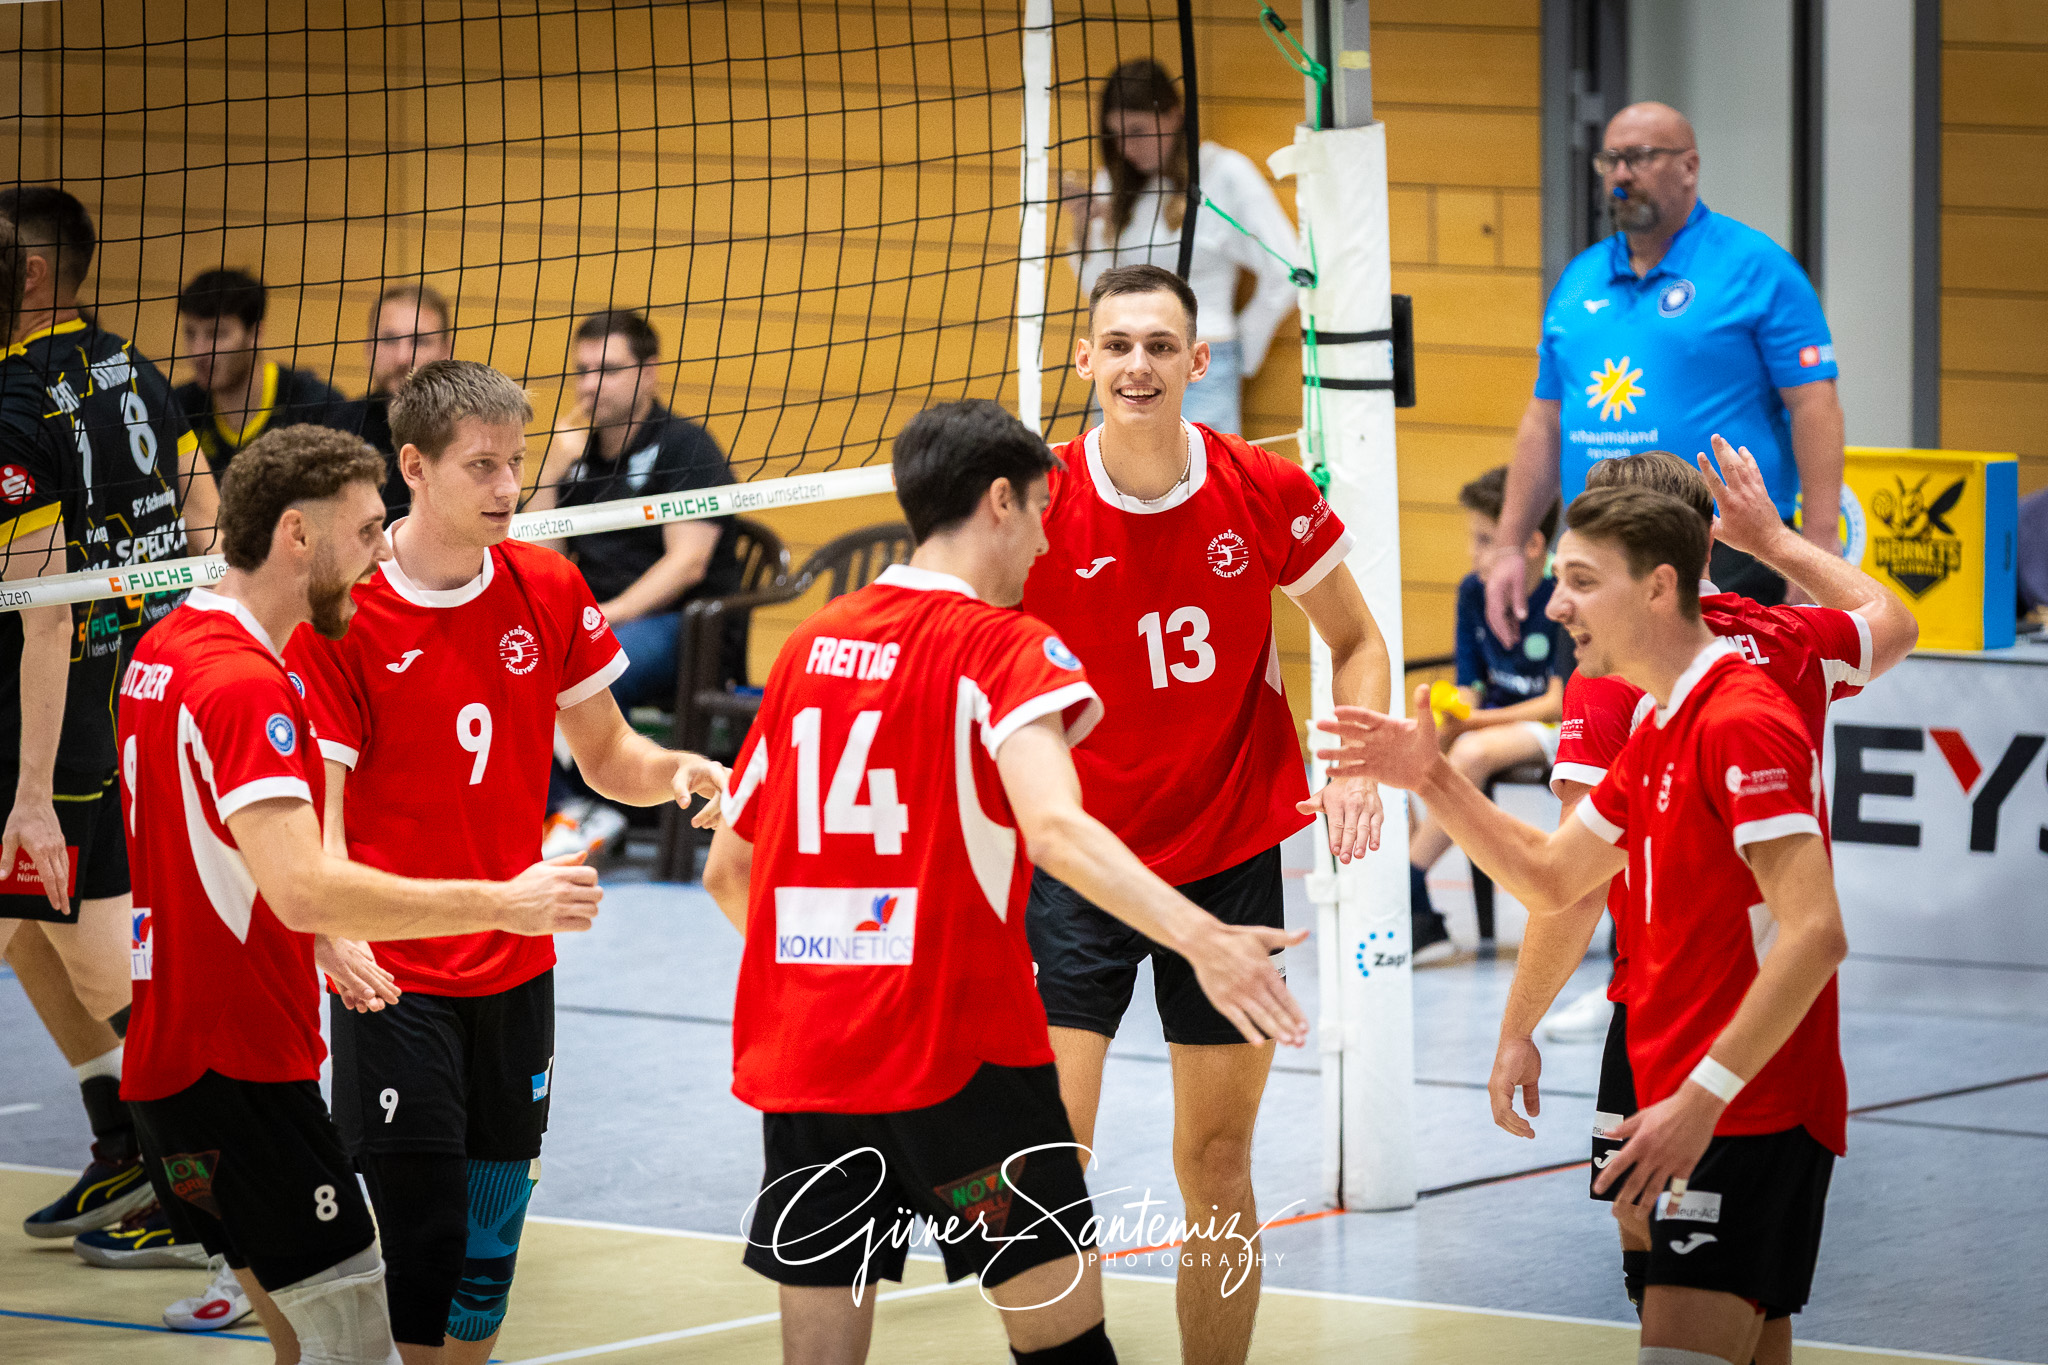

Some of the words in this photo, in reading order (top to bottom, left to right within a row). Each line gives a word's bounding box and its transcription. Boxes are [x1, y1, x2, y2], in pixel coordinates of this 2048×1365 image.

[660, 496, 719, 518] FUCHS
[729, 490, 764, 509] Ideen
[767, 483, 825, 504] umsetzen
[512, 518, 574, 539] umsetzen
[1208, 537, 1219, 550] TUS
[1218, 530, 1245, 546] KRIFTEL
[128, 566, 193, 590] FUCHS
[204, 561, 229, 580] Ide
[1212, 560, 1249, 578] VOLLEYBALL
[499, 633, 509, 647] TUS
[508, 626, 535, 643] KRIFTEL
[1137, 605, 1216, 689] 13
[505, 657, 539, 675] VOLLEYBALL
[805, 635, 901, 681] FREITAG
[456, 702, 493, 785] 9
[791, 706, 909, 855] 14
[1831, 722, 2048, 857] EY
[17, 872, 43, 883] Nürn
[779, 934, 912, 961] KOKINETICS
[1374, 952, 1407, 968] Zap
[378, 1088, 399, 1124] 9
[314, 1184, 339, 1221] 8
